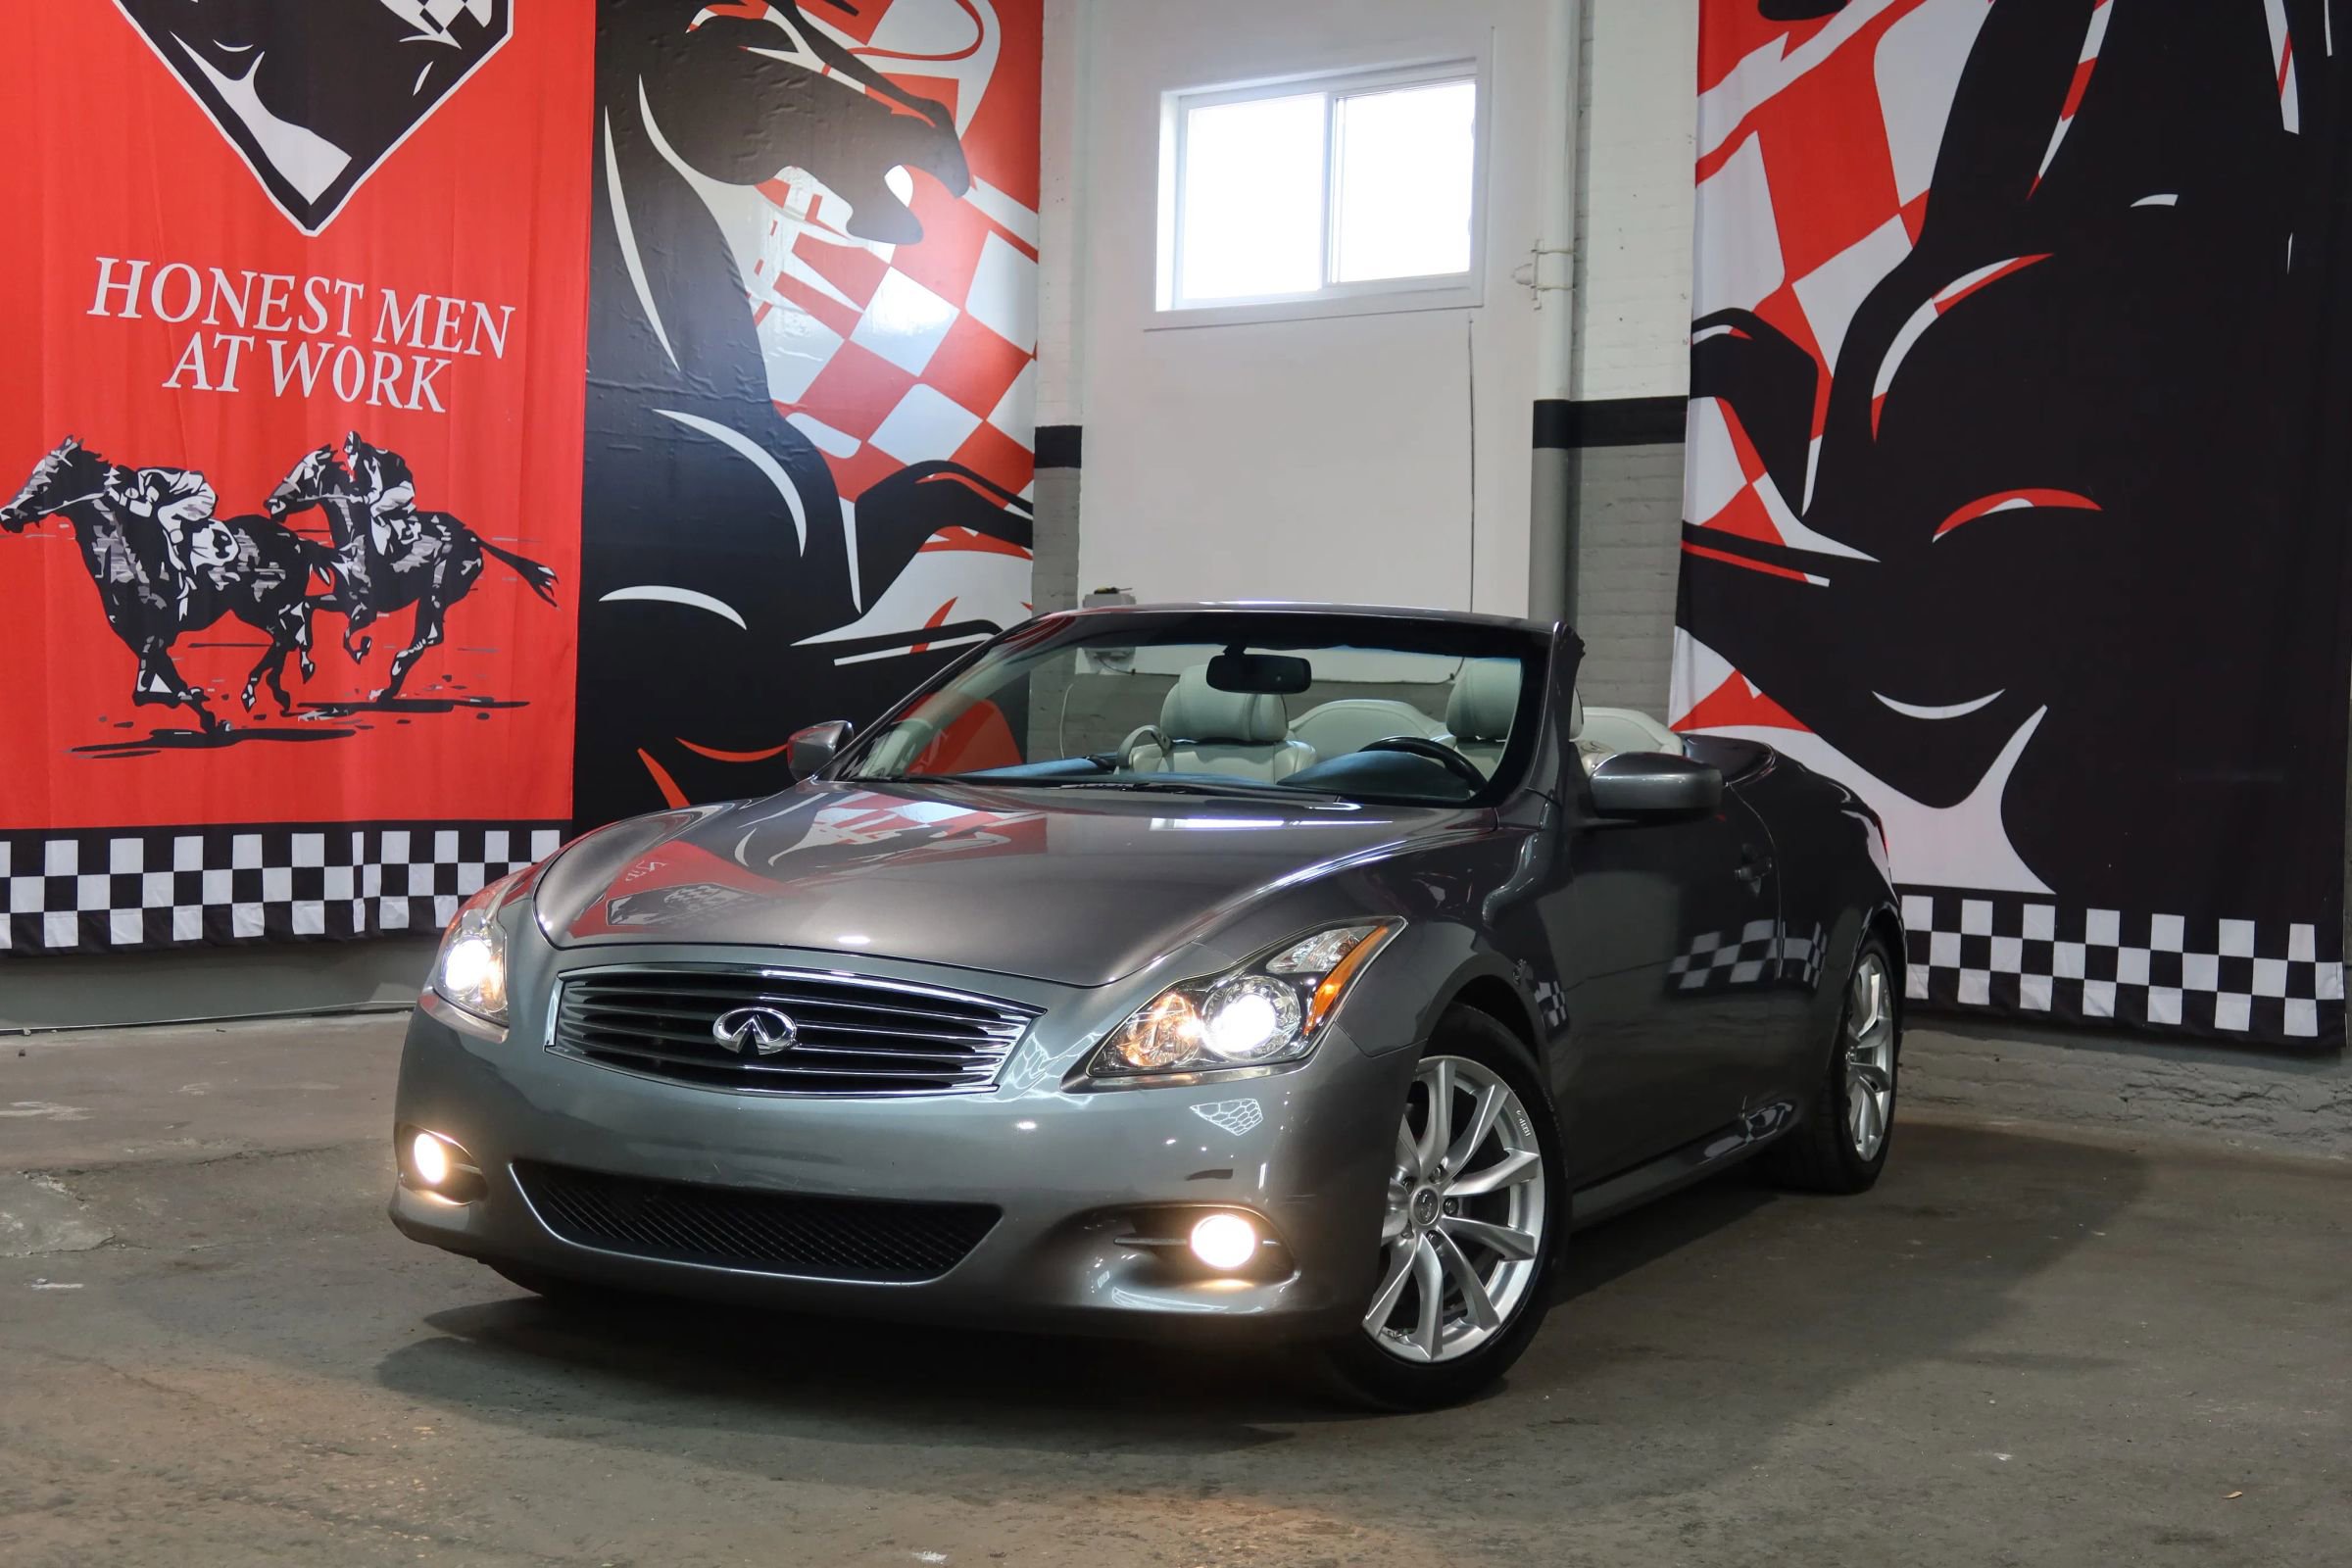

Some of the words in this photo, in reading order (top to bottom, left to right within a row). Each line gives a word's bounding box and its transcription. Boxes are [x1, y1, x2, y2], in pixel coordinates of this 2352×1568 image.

[86, 257, 365, 338] HONEST
[371, 288, 515, 359] MEN
[162, 331, 255, 392] AT
[267, 339, 452, 413] WORK
